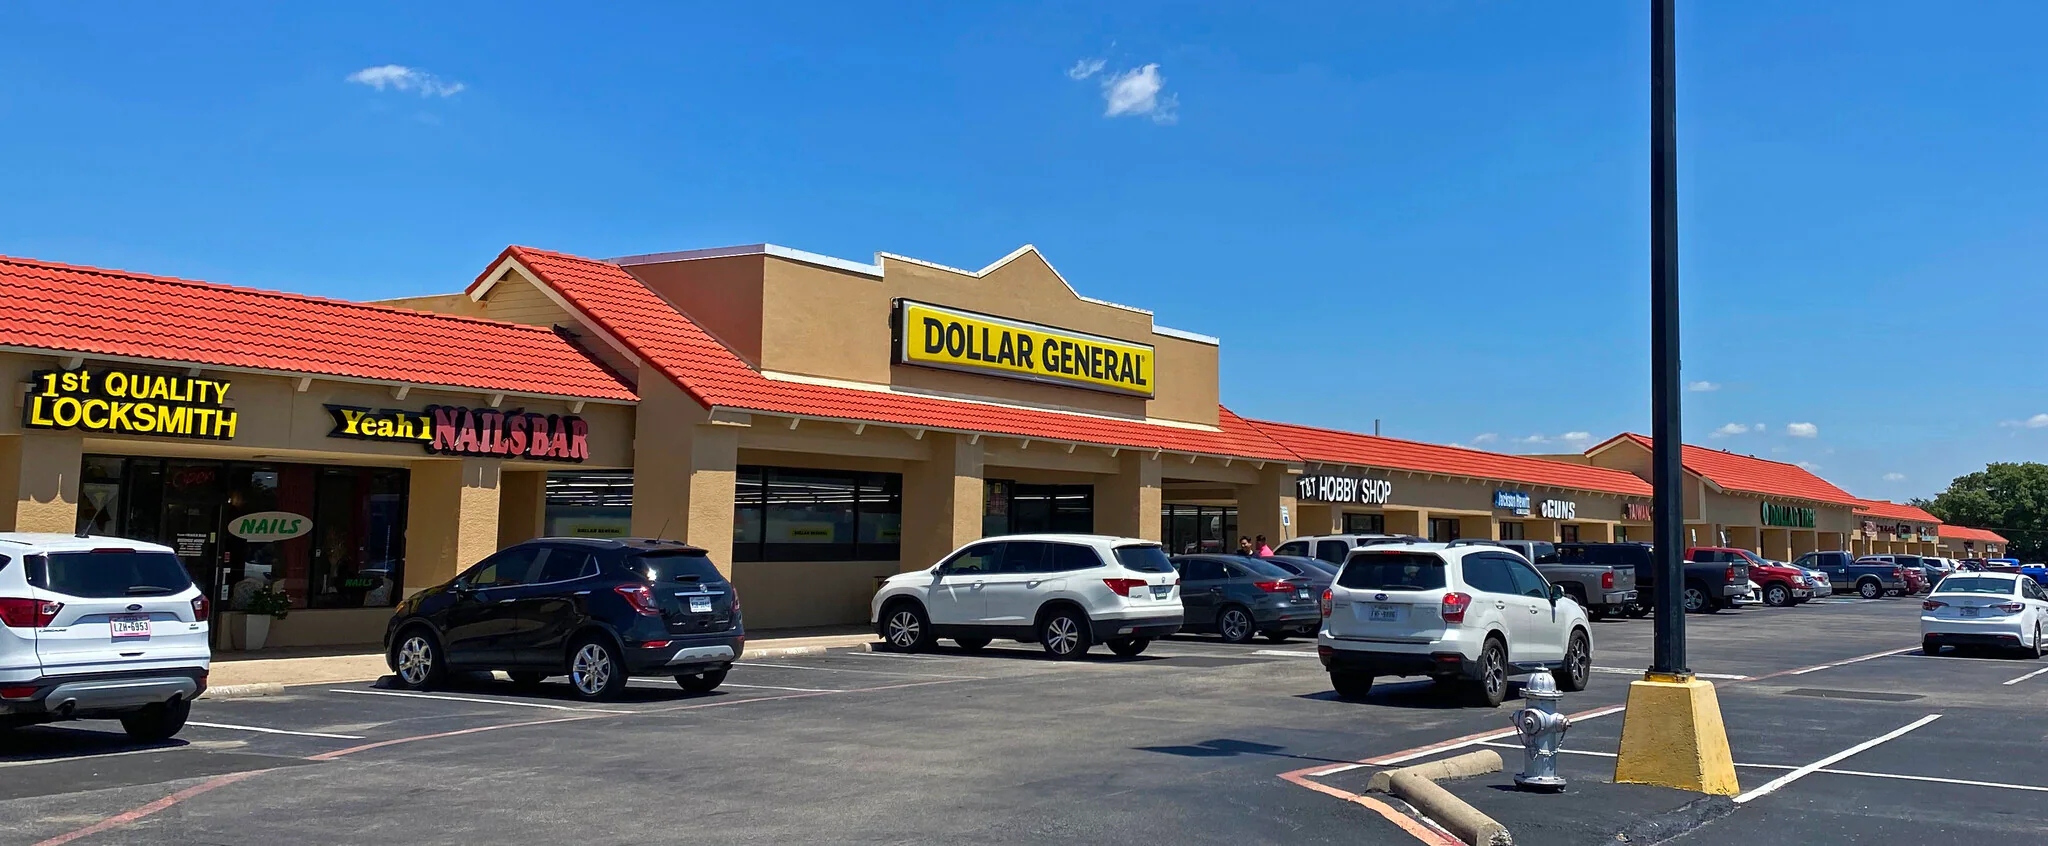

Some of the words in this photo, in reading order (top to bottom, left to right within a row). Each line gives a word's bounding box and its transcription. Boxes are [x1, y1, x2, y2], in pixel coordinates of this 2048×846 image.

[924, 317, 1034, 369] DOLLAR
[1042, 338, 1147, 385] GENERAL
[42, 370, 91, 397] 1st
[105, 371, 231, 404] QUALITY
[30, 396, 238, 438] LOCKSMITH
[433, 408, 527, 456] NAILS
[529, 417, 589, 460] BAR
[1299, 477, 1316, 499] T&T
[1318, 475, 1358, 502] HOBBY
[1361, 479, 1392, 504] SHOP
[1547, 500, 1575, 520] GUNS
[1769, 504, 1800, 527] DOLLAR
[1801, 507, 1817, 528] TREE
[239, 519, 302, 535] NAILS
[344, 578, 373, 587] NAILS
